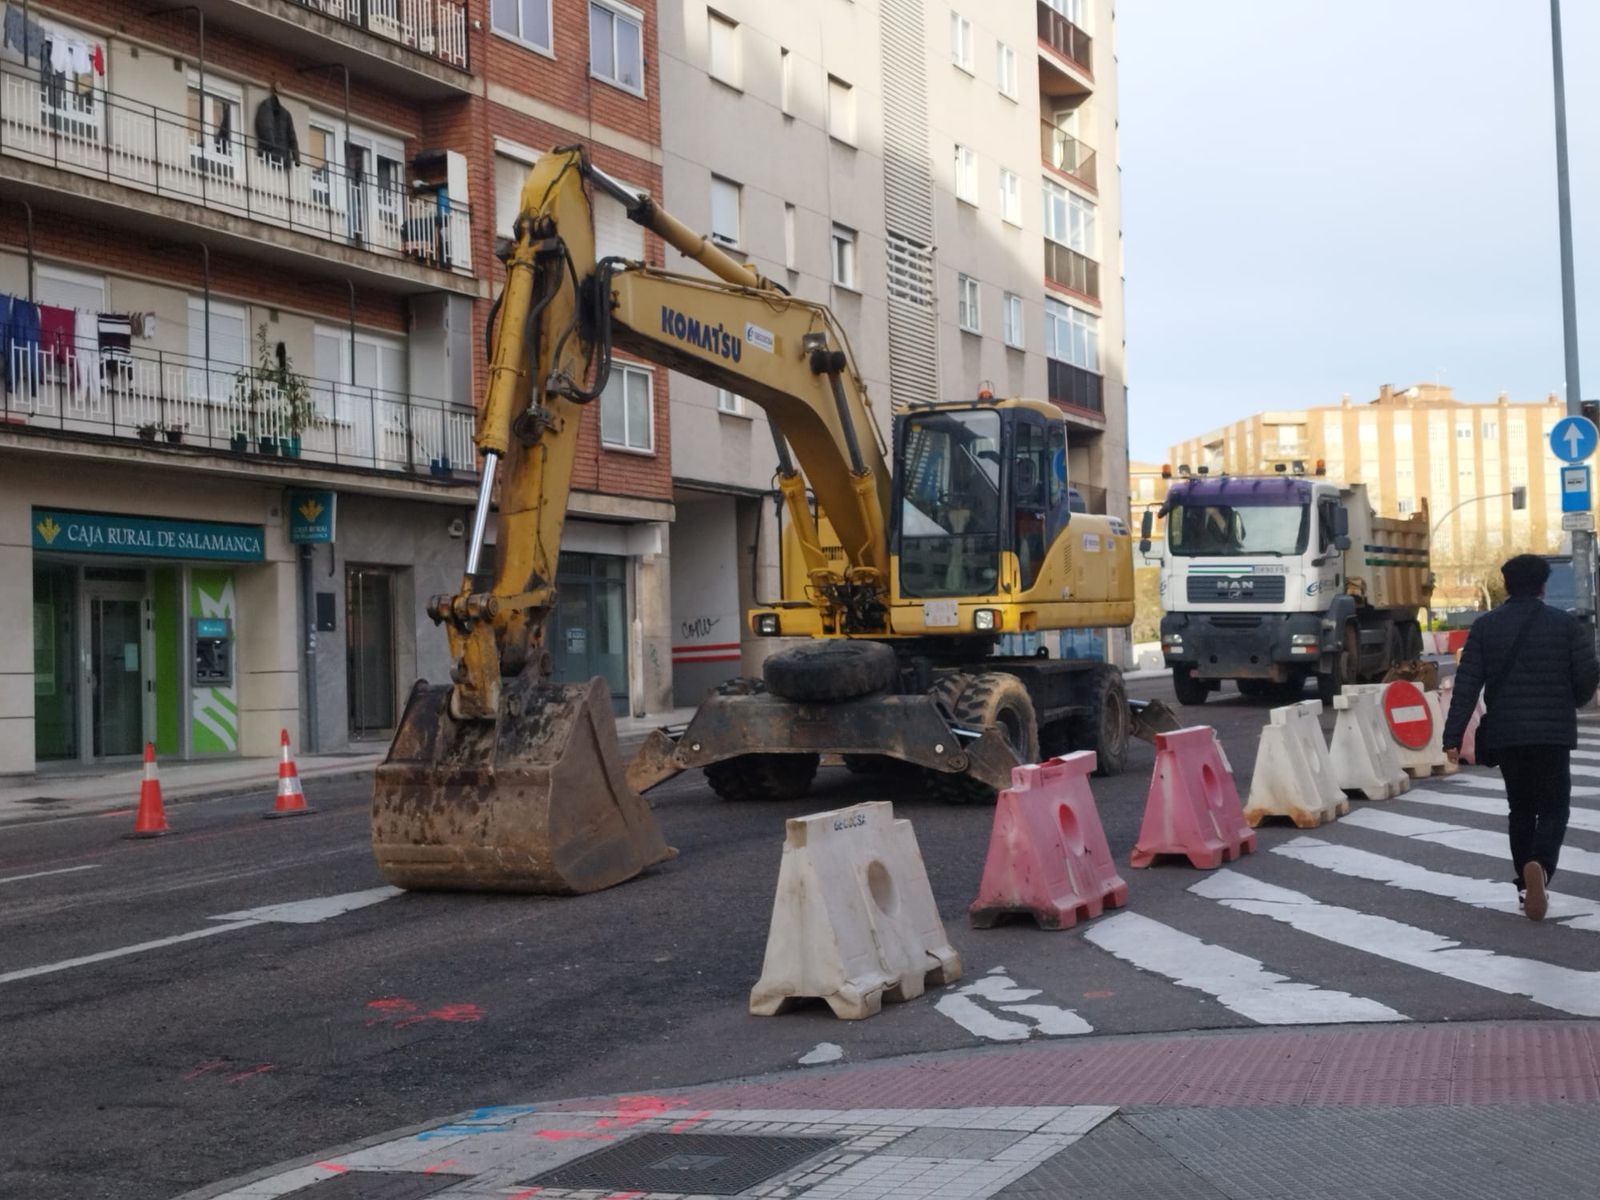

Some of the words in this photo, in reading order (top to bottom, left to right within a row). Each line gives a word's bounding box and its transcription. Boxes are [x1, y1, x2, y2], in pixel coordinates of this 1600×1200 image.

[661, 304, 742, 364] KOMATSU
[67, 524, 104, 547] CAJA
[107, 527, 154, 547] RURAL
[157, 530, 176, 547] DE
[178, 532, 262, 553] SALAMANCA
[1216, 580, 1255, 590] MAN
